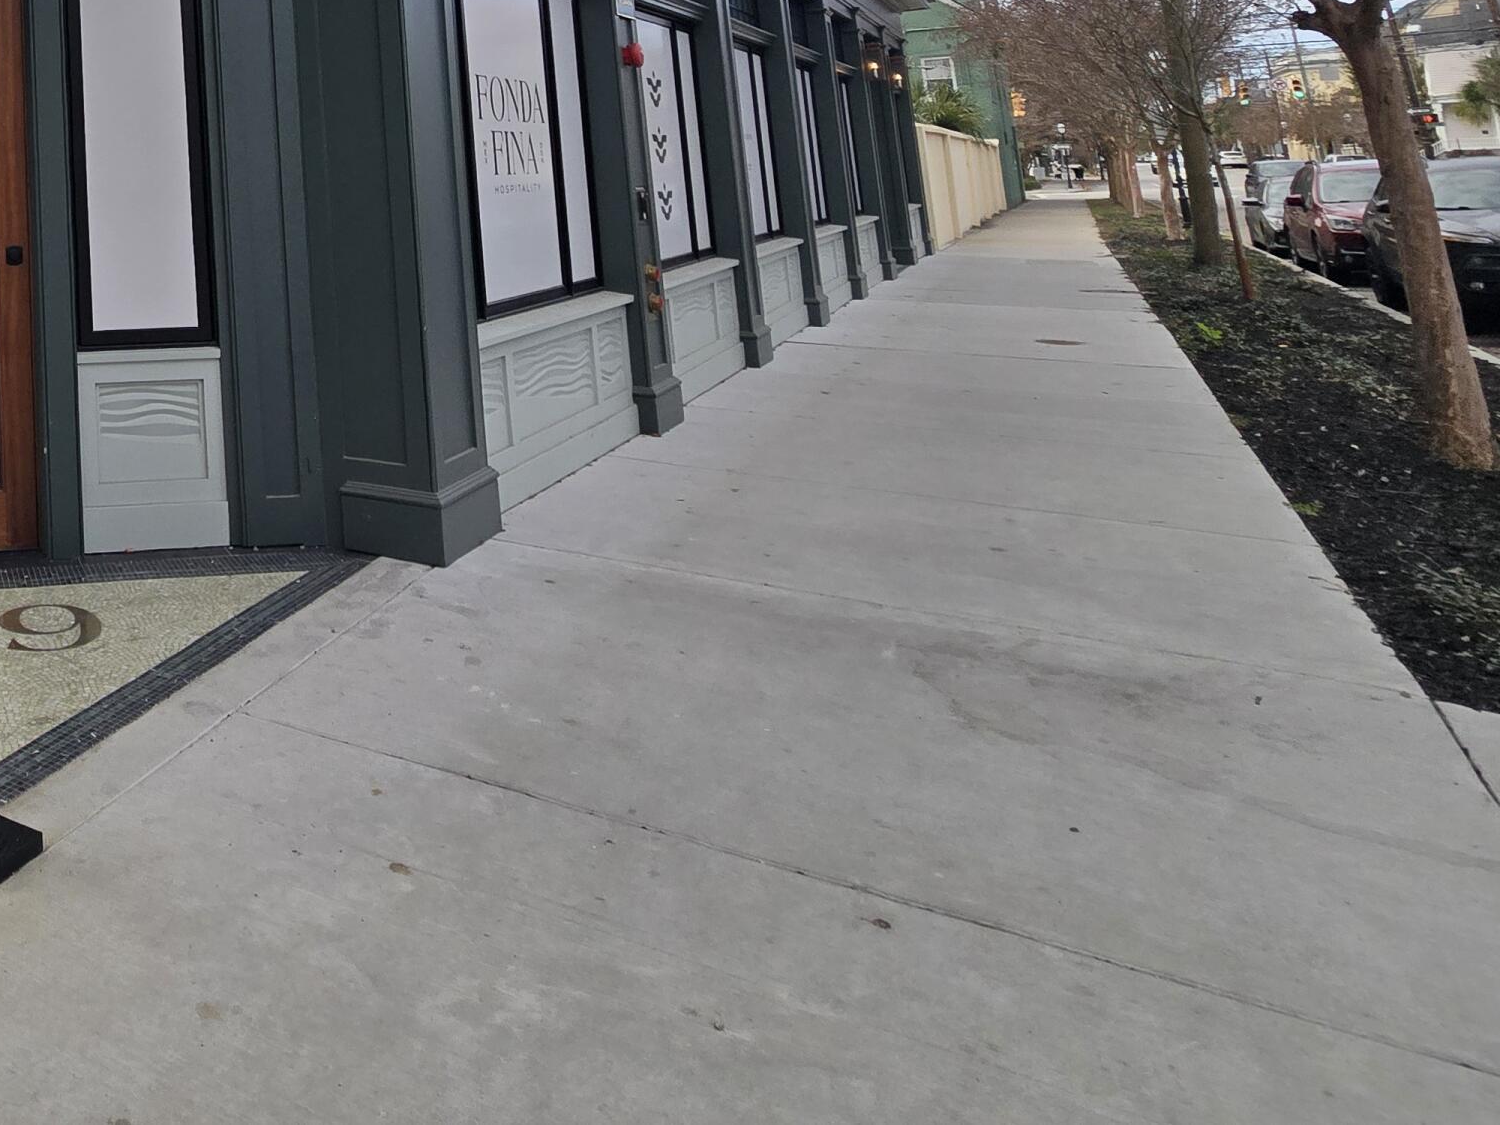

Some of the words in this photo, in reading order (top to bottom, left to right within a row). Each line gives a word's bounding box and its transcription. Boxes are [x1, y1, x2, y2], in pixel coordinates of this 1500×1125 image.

[475, 73, 545, 123] FONDA
[491, 130, 539, 175] FINA
[494, 183, 541, 195] HOSPITALITY
